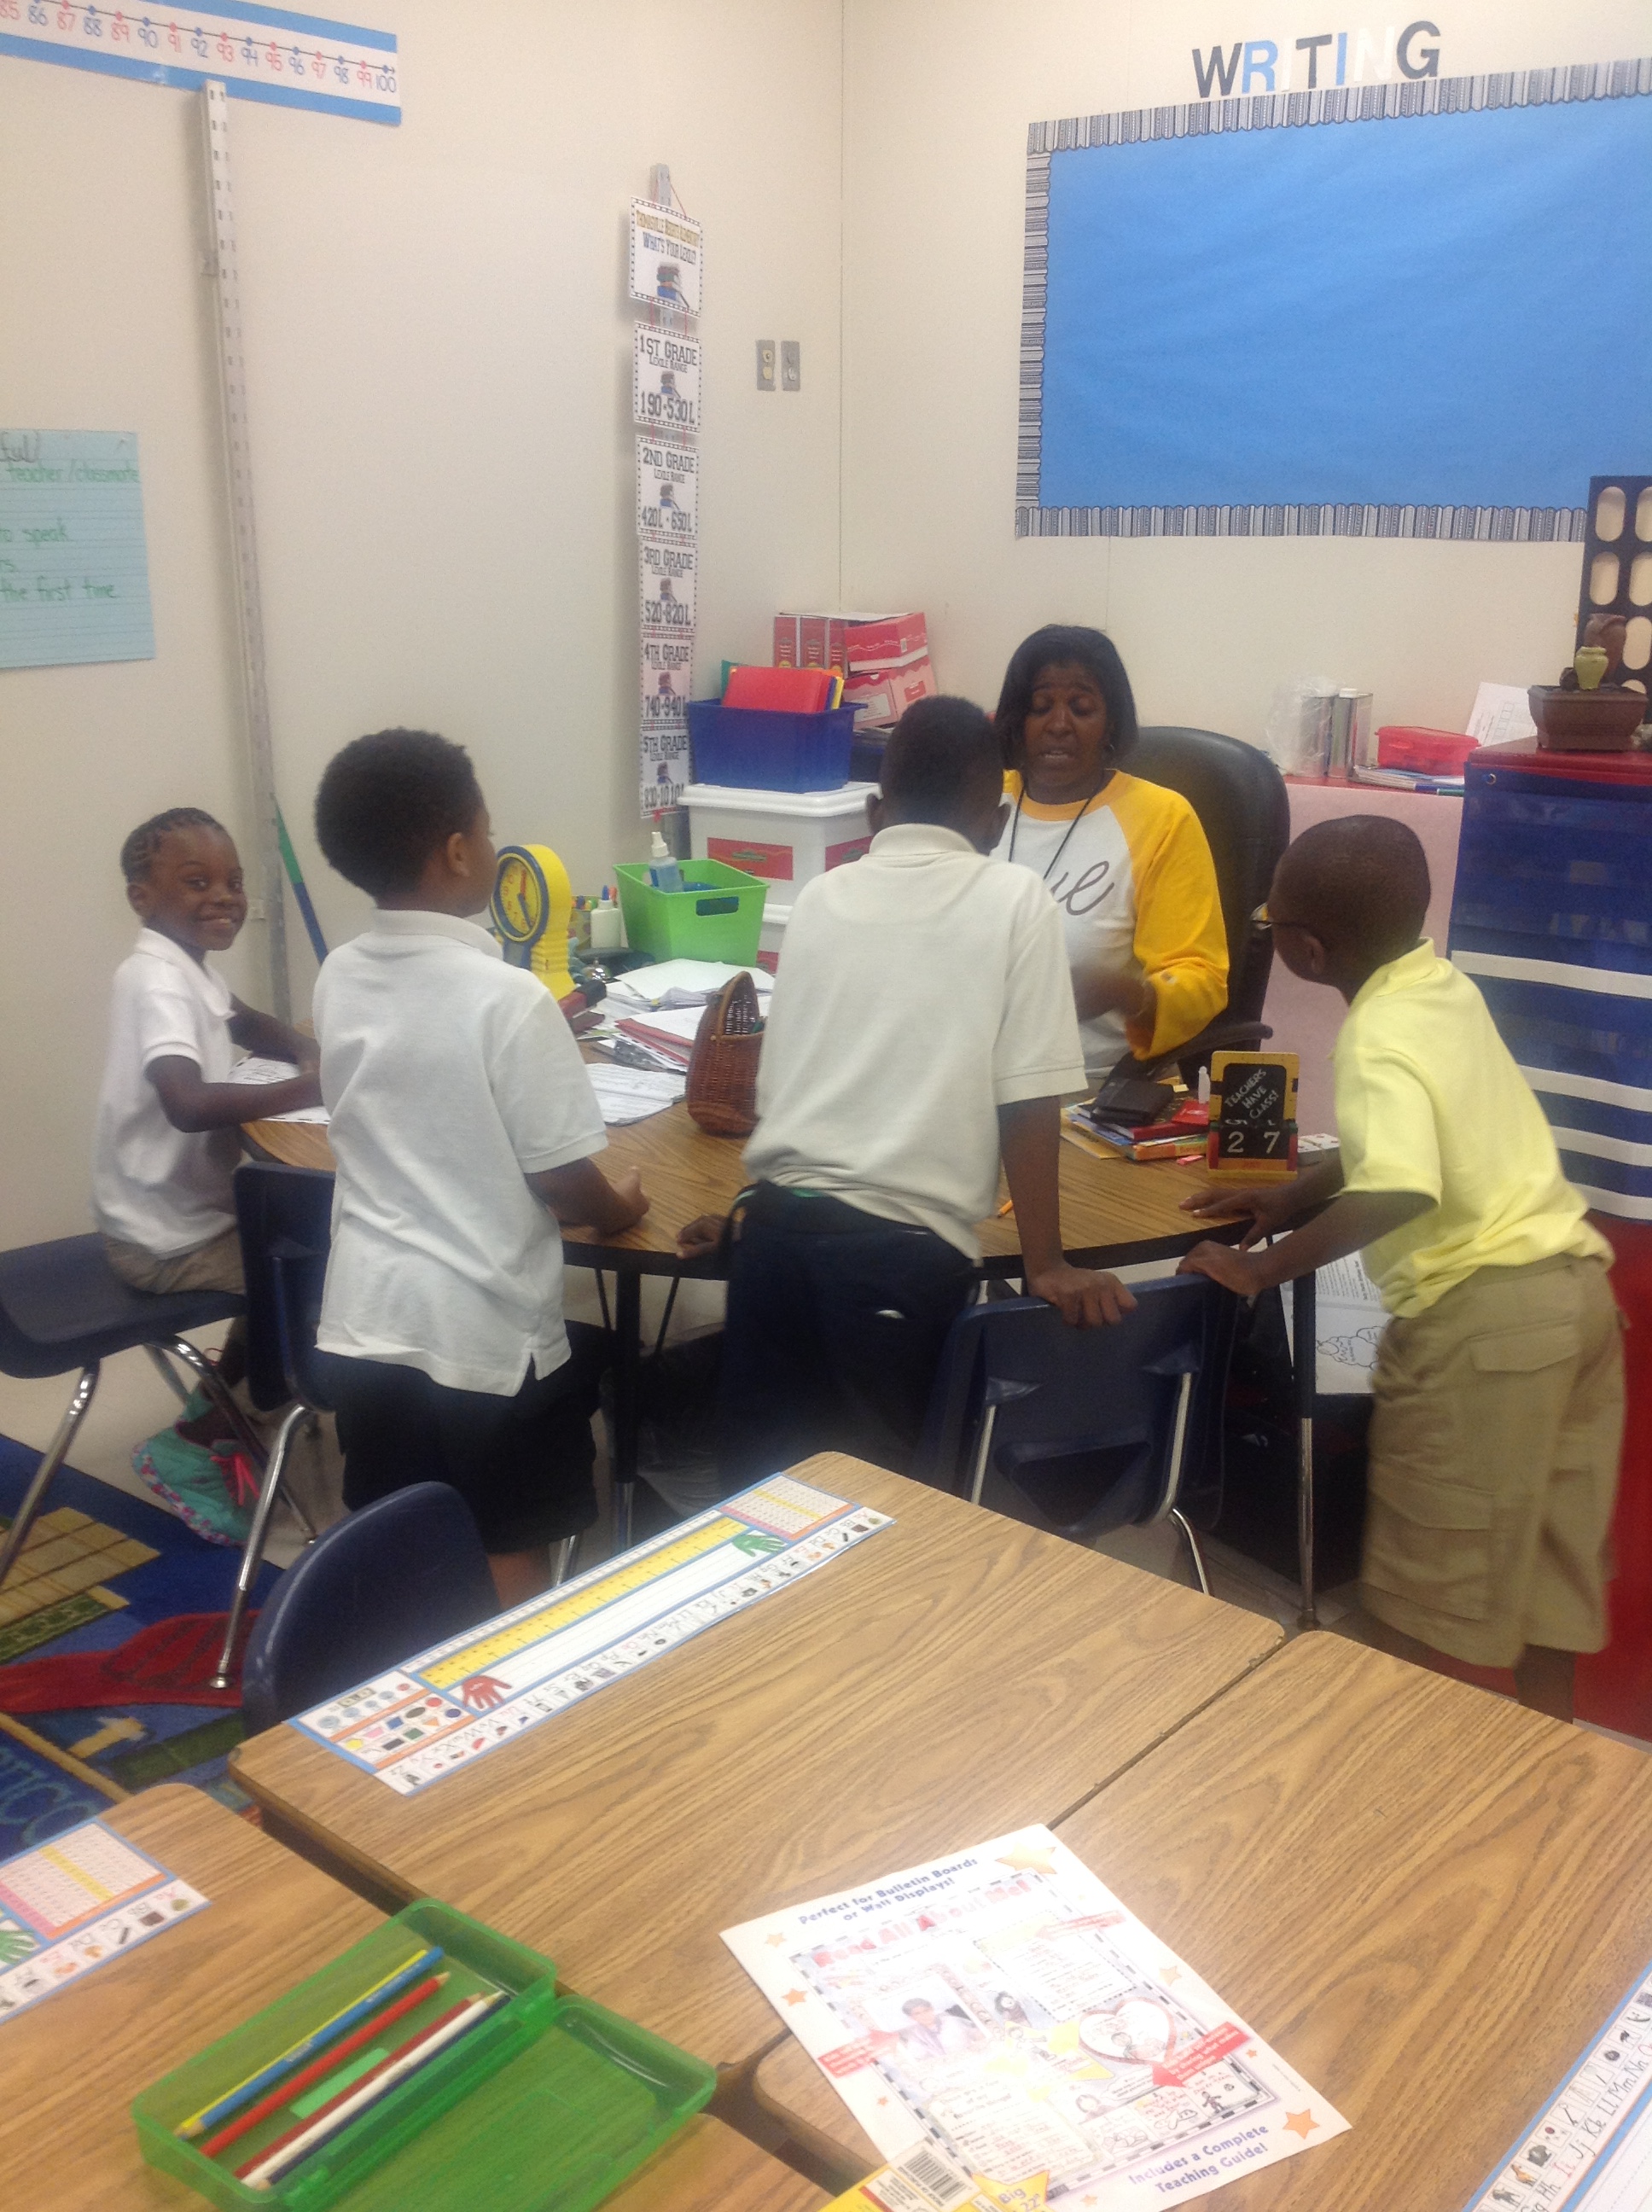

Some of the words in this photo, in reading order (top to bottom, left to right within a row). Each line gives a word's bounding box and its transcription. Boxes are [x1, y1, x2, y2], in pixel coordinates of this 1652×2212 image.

[28, 7, 49, 26] 86
[56, 10, 77, 30] 87
[84, 16, 102, 37] 88
[111, 20, 130, 43] 89
[138, 26, 158, 48] 90
[168, 32, 182, 53] 91
[191, 36, 208, 58] 92
[217, 40, 235, 62] 93
[241, 44, 258, 67] 94
[265, 49, 283, 71] 95
[288, 53, 305, 75] 96
[311, 57, 327, 79] 97
[334, 61, 349, 84] 98
[357, 65, 372, 88] 99
[375, 71, 397, 93] 100
[1192, 20, 1440, 98] WRITING
[640, 335, 660, 357] 1ST
[665, 341, 697, 366] GRADE
[643, 446, 662, 467] 2ND
[666, 451, 695, 474] GRADE
[664, 549, 693, 570] GRADE
[645, 643, 660, 661] 4TH
[663, 643, 689, 661] GRADE
[643, 736, 659, 753] 5TH
[660, 735, 687, 751] GRADE
[1224, 1068, 1267, 1107] TEACHERS
[1242, 1086, 1267, 1109] HAVE
[1227, 1131, 1244, 1153] 2
[1264, 1131, 1280, 1154] 7
[798, 1901, 850, 1924] Perfect
[852, 1895, 874, 1906] for
[875, 1876, 930, 1898] Bulletin
[931, 1858, 978, 1878] Boards
[843, 1911, 858, 1921] or
[861, 1899, 892, 1912] Wall
[894, 1877, 956, 1903] Displays!
[1128, 2157, 1188, 2185] Includes
[1191, 2152, 1201, 2162] a
[1202, 2125, 1269, 2156] Complete
[1155, 2165, 1219, 2193] Teaching
[1220, 2142, 1269, 2168] Guide!
[998, 2188, 1027, 2204] Big
